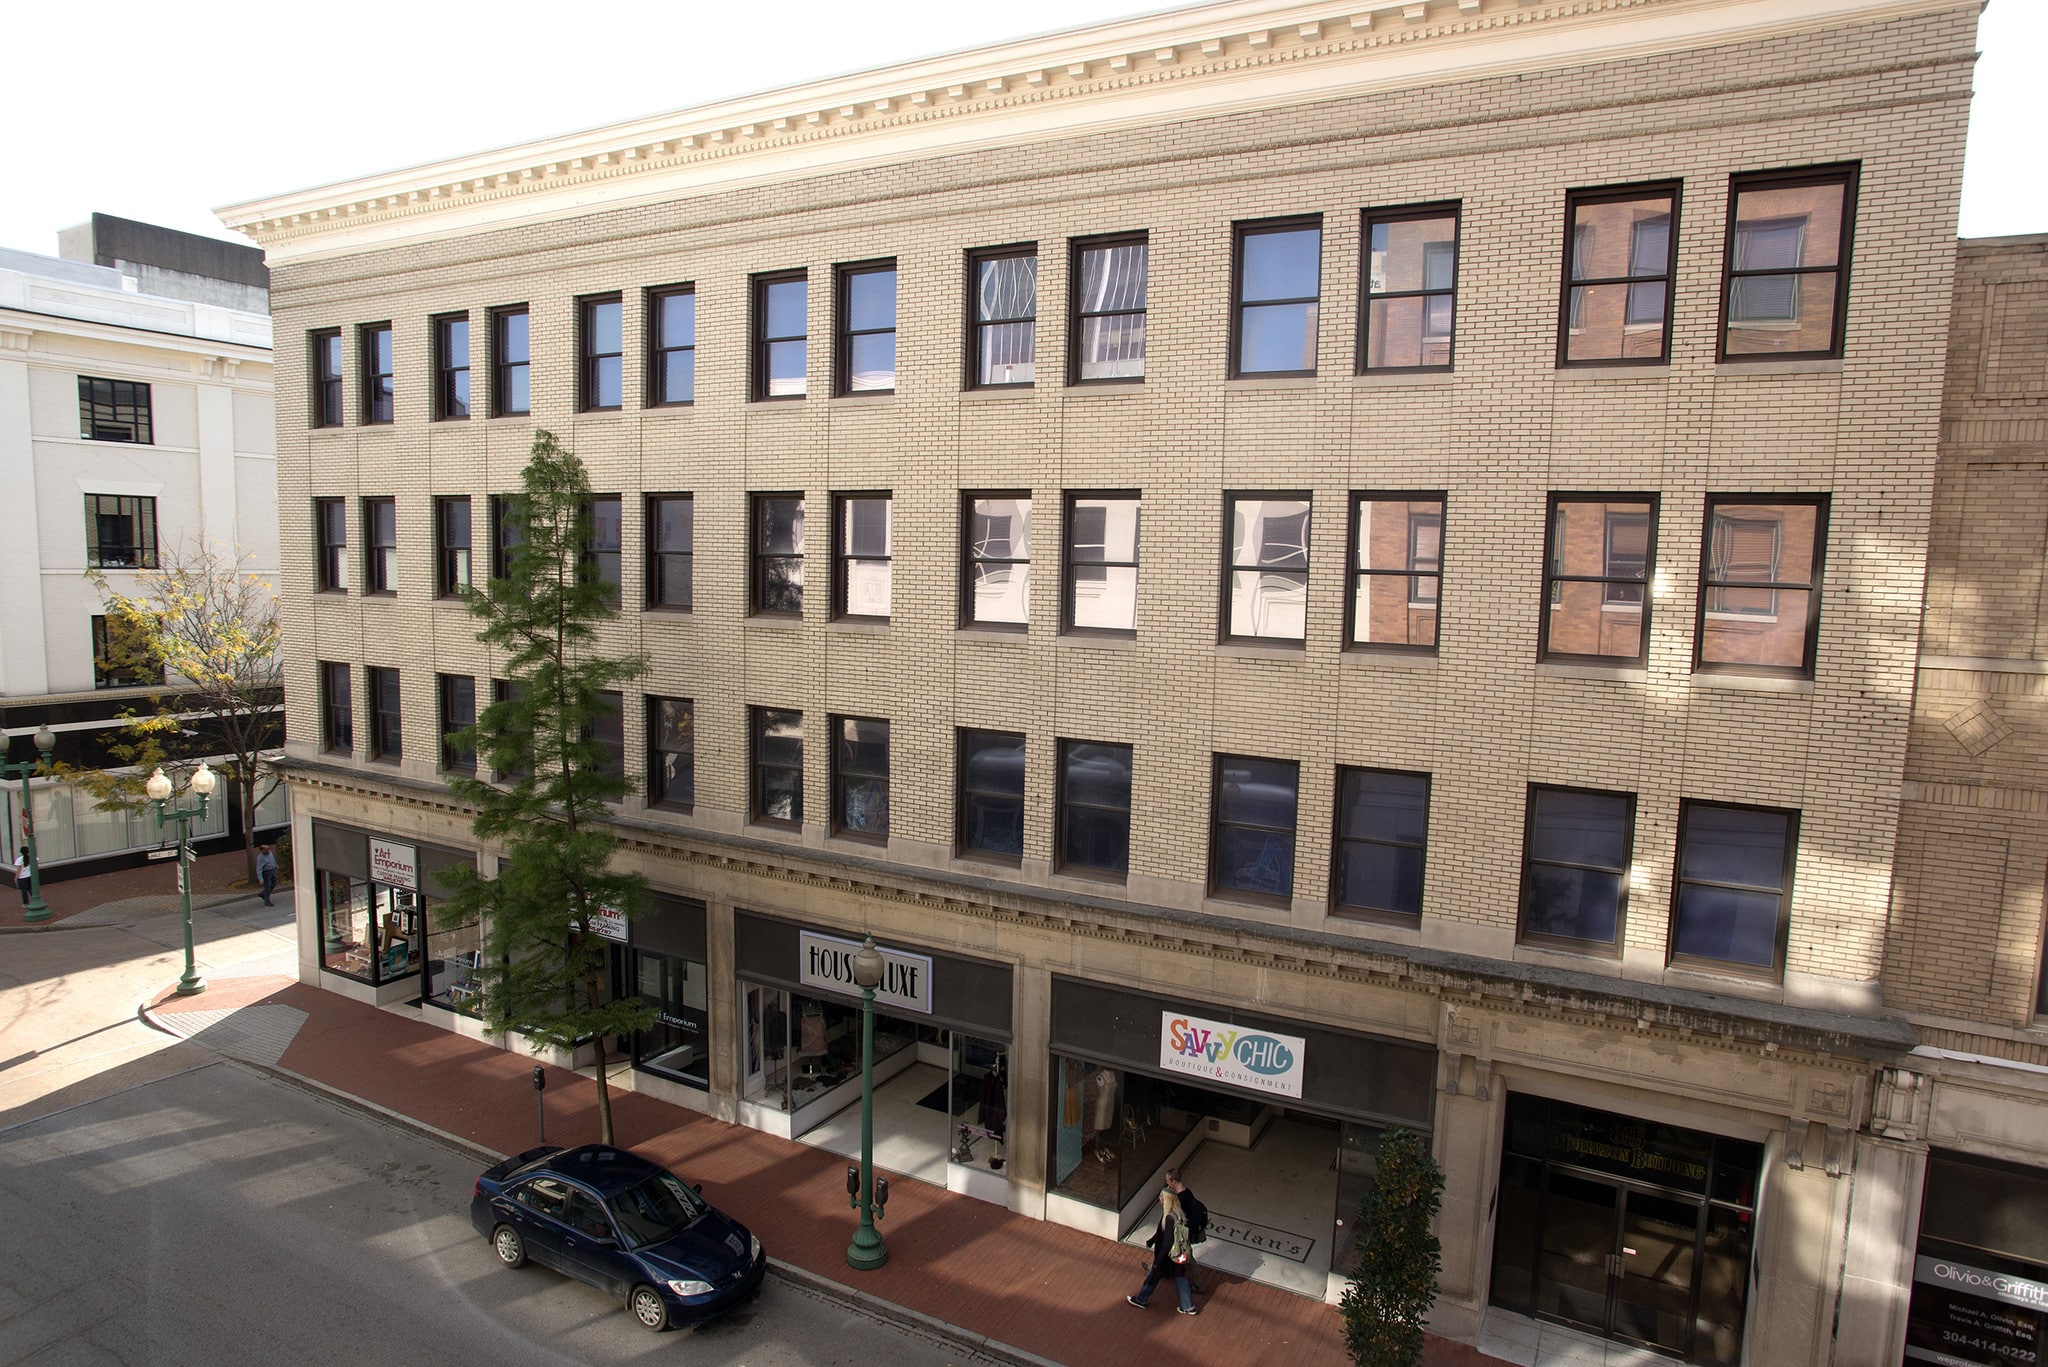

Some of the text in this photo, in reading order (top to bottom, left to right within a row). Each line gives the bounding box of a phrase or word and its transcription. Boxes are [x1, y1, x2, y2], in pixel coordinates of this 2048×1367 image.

[375, 855, 413, 872] Emporium
[379, 847, 391, 859] Art
[810, 946, 858, 986] HOUS
[663, 1012, 698, 1029] Emporium
[1237, 1040, 1289, 1069] CHIC
[1169, 1057, 1292, 1091] BOUTIQUE & CONSIGNMENT
[1552, 1132, 1706, 1180] MORRISON BUILDING
[1998, 1291, 2029, 1303] attorneys
[1949, 1303, 2036, 1332] Michael A. Olivio, Esq.
[1949, 1313, 1972, 1326] Travis
[1984, 1321, 2014, 1336] Griffith,
[2015, 1329, 2034, 1341] Esq.
[1942, 1330, 2037, 1362] 304-414-0222
